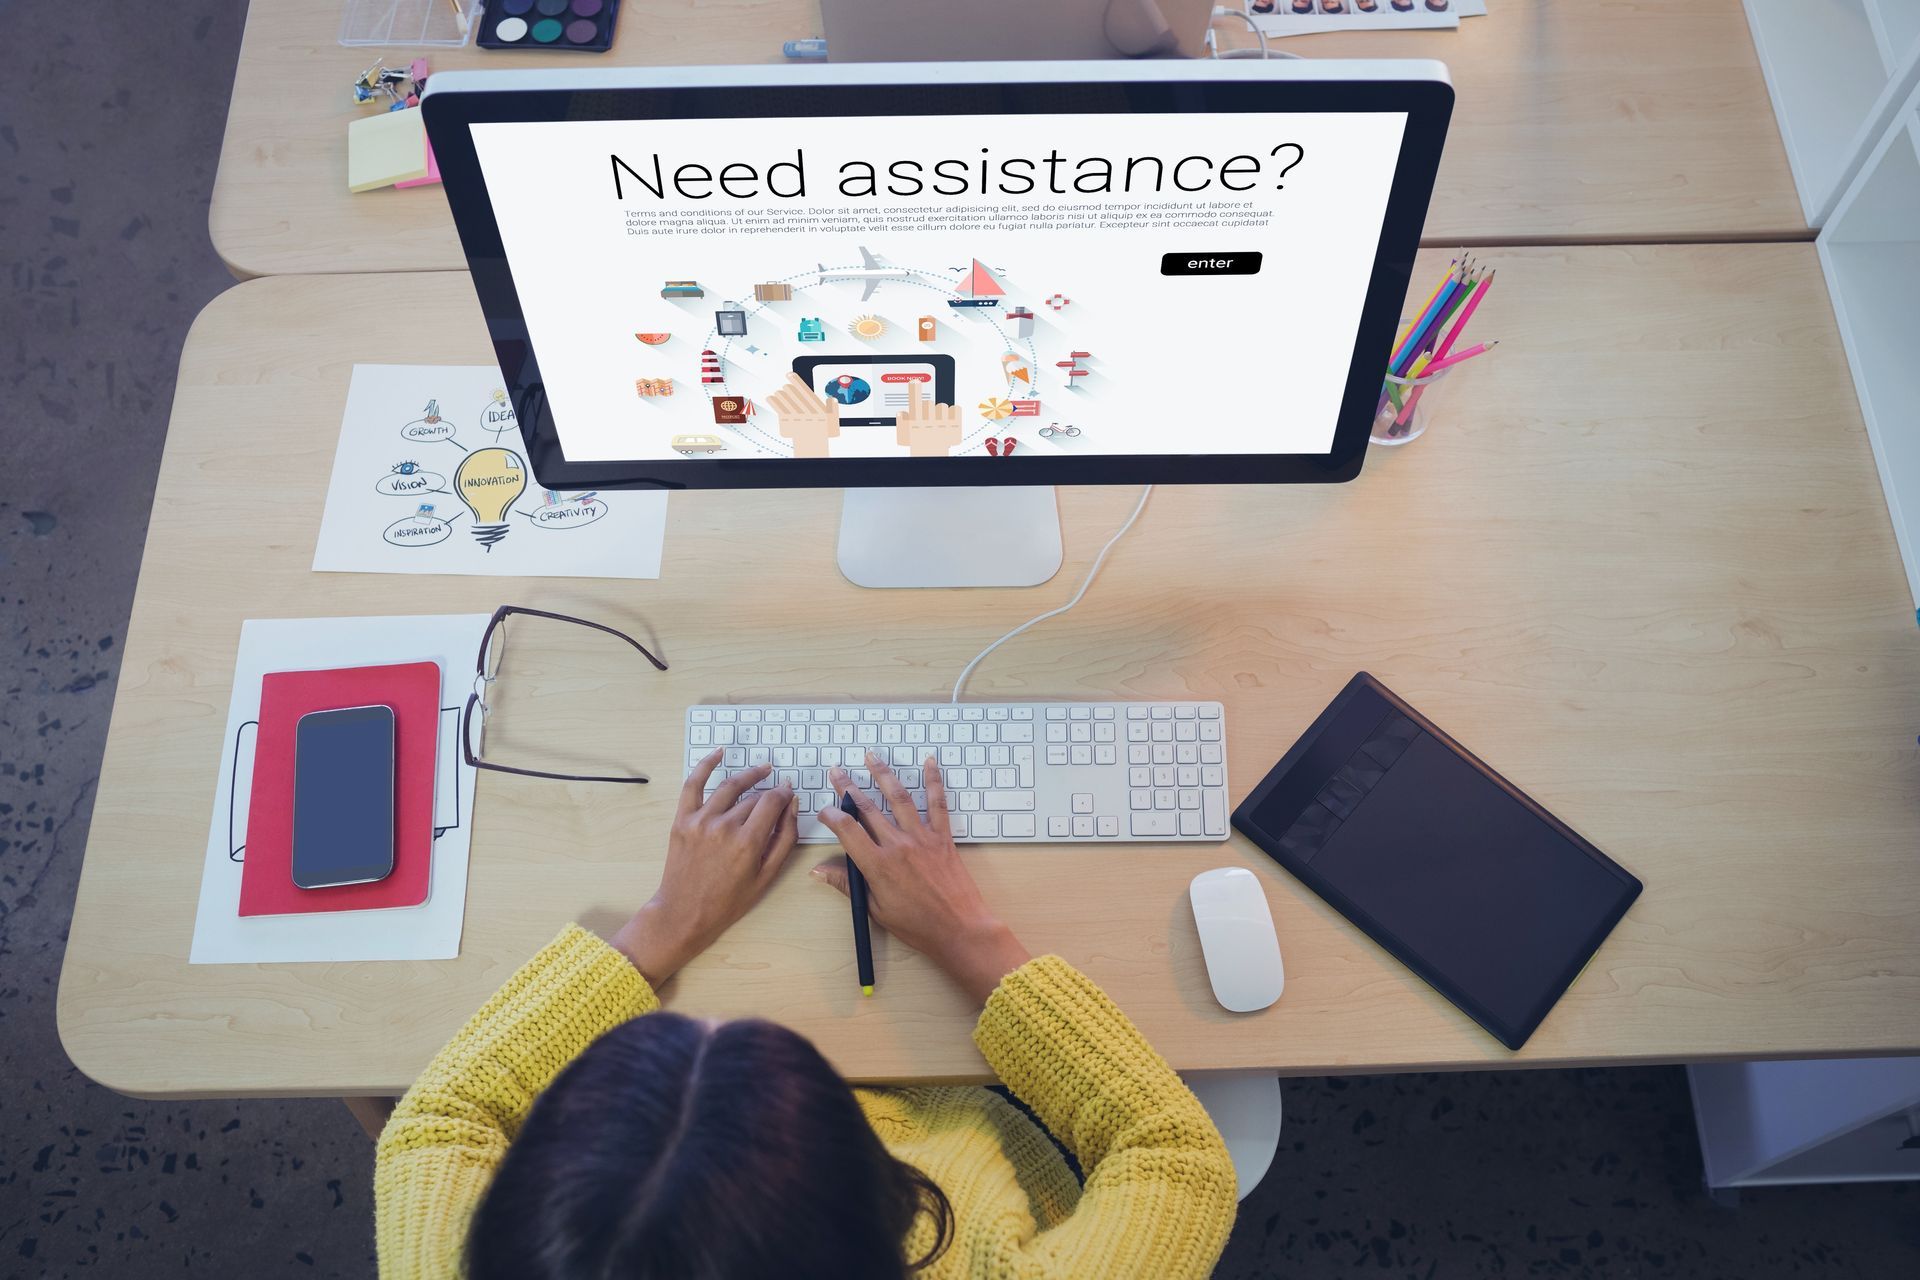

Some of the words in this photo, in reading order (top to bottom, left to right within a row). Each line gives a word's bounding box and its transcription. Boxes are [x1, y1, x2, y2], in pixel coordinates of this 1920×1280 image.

[611, 148, 806, 200] Need
[838, 142, 1305, 197] assistance?
[626, 209, 656, 218] Terms
[659, 209, 677, 217] and
[681, 208, 732, 217] conditions
[735, 208, 744, 216] of
[767, 207, 805, 216] Service.
[809, 207, 834, 215] Dolor
[838, 207, 849, 215] sit
[853, 206, 880, 216] amet,
[884, 205, 942, 214] consectetur
[946, 205, 998, 215] adipisicing
[1002, 204, 1018, 214] elit,
[1022, 204, 1039, 212] sed
[1043, 204, 1055, 212] do
[1058, 203, 1101, 212] eiusmod
[1105, 203, 1140, 213] tempor
[1144, 202, 1192, 210] incididunt
[1196, 202, 1205, 210] ut
[1209, 201, 1240, 209] labore
[1243, 201, 1253, 209] et
[626, 218, 656, 227] dolore
[660, 219, 693, 228] magna
[697, 217, 728, 227] aliqua.
[732, 217, 742, 225] Ut
[745, 217, 770, 225] enim
[773, 216, 784, 225] ad
[788, 216, 819, 224] minim
[822, 215, 860, 226] veniam,
[863, 215, 883, 225] quis
[887, 215, 925, 223] nostrud
[928, 214, 985, 222] exercitation
[989, 213, 1028, 222] ullamco
[1032, 213, 1064, 221] laboris
[1068, 212, 1084, 220] nisi
[1088, 212, 1097, 220] ut
[1100, 212, 1133, 222] aliquip
[1165, 210, 1217, 219] commodo
[1220, 210, 1274, 220] consequat.
[627, 227, 649, 236] Duis
[652, 227, 673, 235] aute
[676, 227, 698, 235] irure
[701, 226, 725, 235] dolor
[729, 226, 737, 234] in
[741, 225, 805, 236] reprehenderit
[809, 225, 817, 233] in
[820, 224, 865, 235] voluptate
[869, 224, 888, 232] velit
[917, 223, 946, 232] cillum
[950, 223, 980, 231] dolore
[999, 222, 1026, 232] fugiat
[1030, 222, 1053, 230] nulla
[1056, 221, 1095, 231] pariatur.
[1100, 220, 1149, 231] Excepteur
[1152, 220, 1170, 228] sint
[1173, 219, 1218, 228] occaecat
[1222, 219, 1268, 229] cupidatat
[1187, 256, 1234, 270] enter
[408, 427, 449, 437] GROWTH
[391, 477, 428, 491] VISION
[464, 474, 520, 488] INNOVATION
[539, 507, 597, 521] CREATIVITY
[393, 525, 443, 538] INSPIRATION
